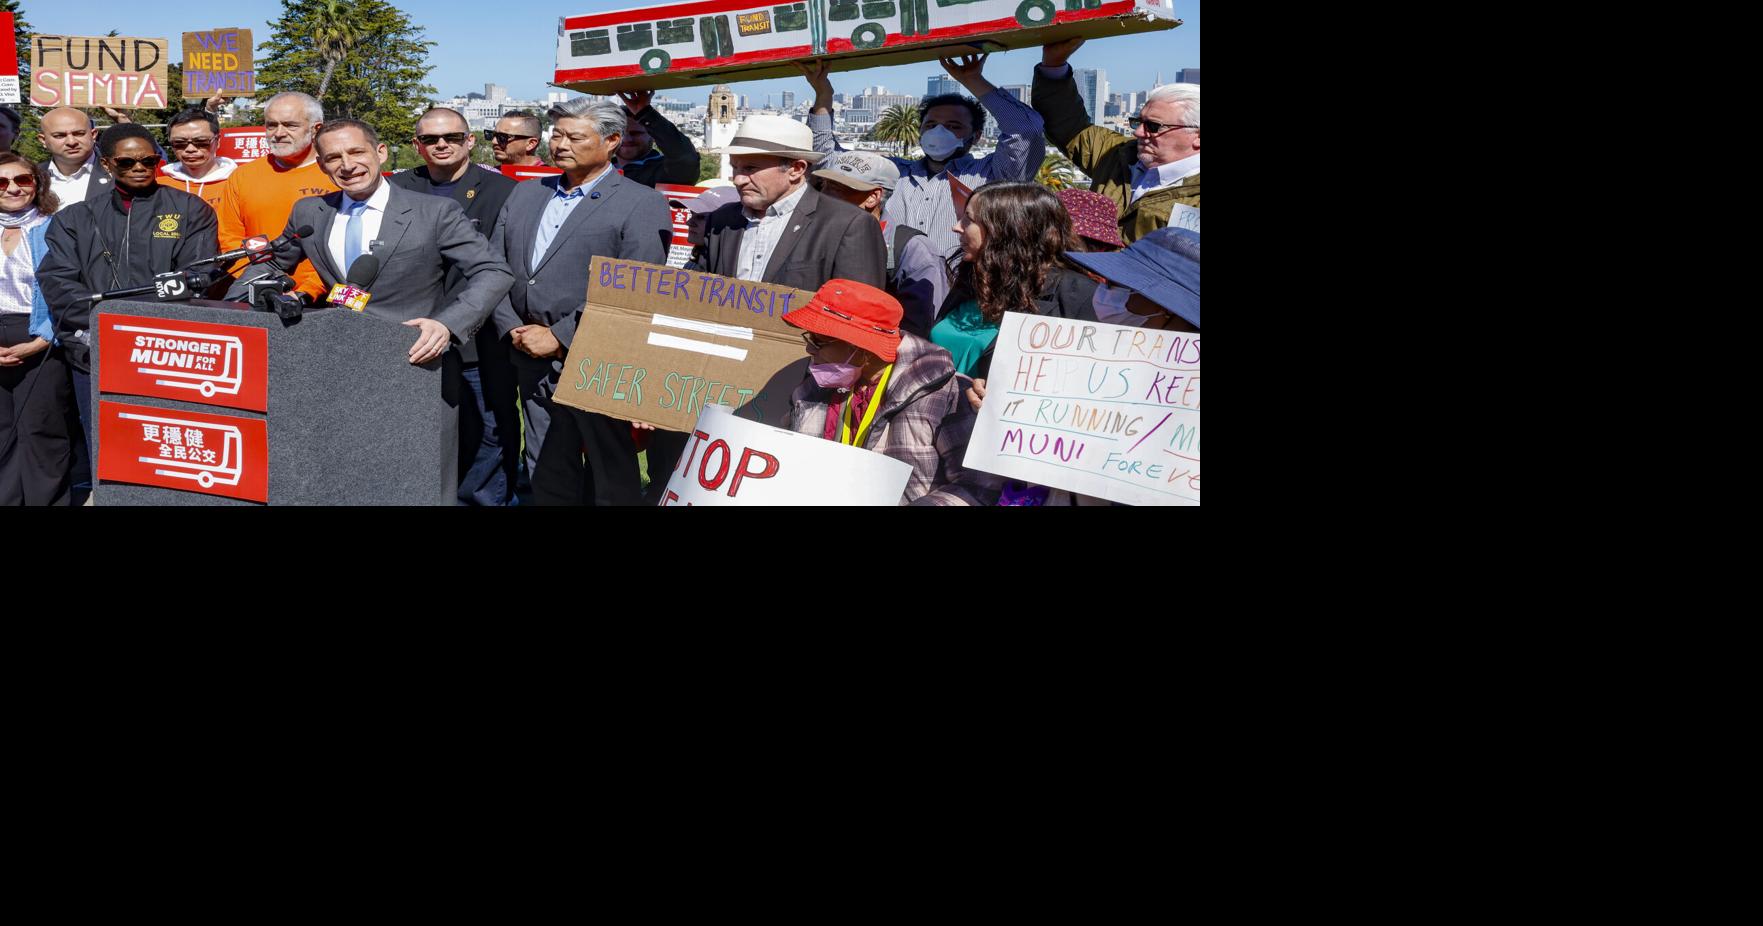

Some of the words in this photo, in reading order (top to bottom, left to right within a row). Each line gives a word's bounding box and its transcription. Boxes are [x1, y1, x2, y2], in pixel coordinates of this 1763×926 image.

[741, 20, 770, 32] TRANSIT
[194, 31, 240, 51] WE
[37, 36, 160, 72] FUND
[188, 52, 239, 71] NEED
[31, 69, 168, 108] SFMTA
[183, 71, 254, 93] TRANSIT
[241, 148, 271, 158] 全民公
[155, 281, 166, 298] KTVU
[599, 261, 690, 300] BETTER
[699, 274, 796, 317] TRANSIT
[134, 335, 222, 355] STRONGER
[1112, 329, 1200, 364] TRANS
[130, 348, 194, 369] MUNI
[196, 355, 216, 365] FOR
[194, 362, 214, 372] ALL
[575, 358, 648, 405] SAFER
[1087, 362, 1131, 399] US
[1145, 371, 1200, 408] KEE
[1003, 399, 1025, 417] IT
[1035, 399, 1143, 436] RUNNING
[141, 423, 205, 449] 更穩健
[1000, 428, 1085, 462] MUNI
[159, 445, 217, 464] 全民公交
[675, 429, 780, 498] TOP
